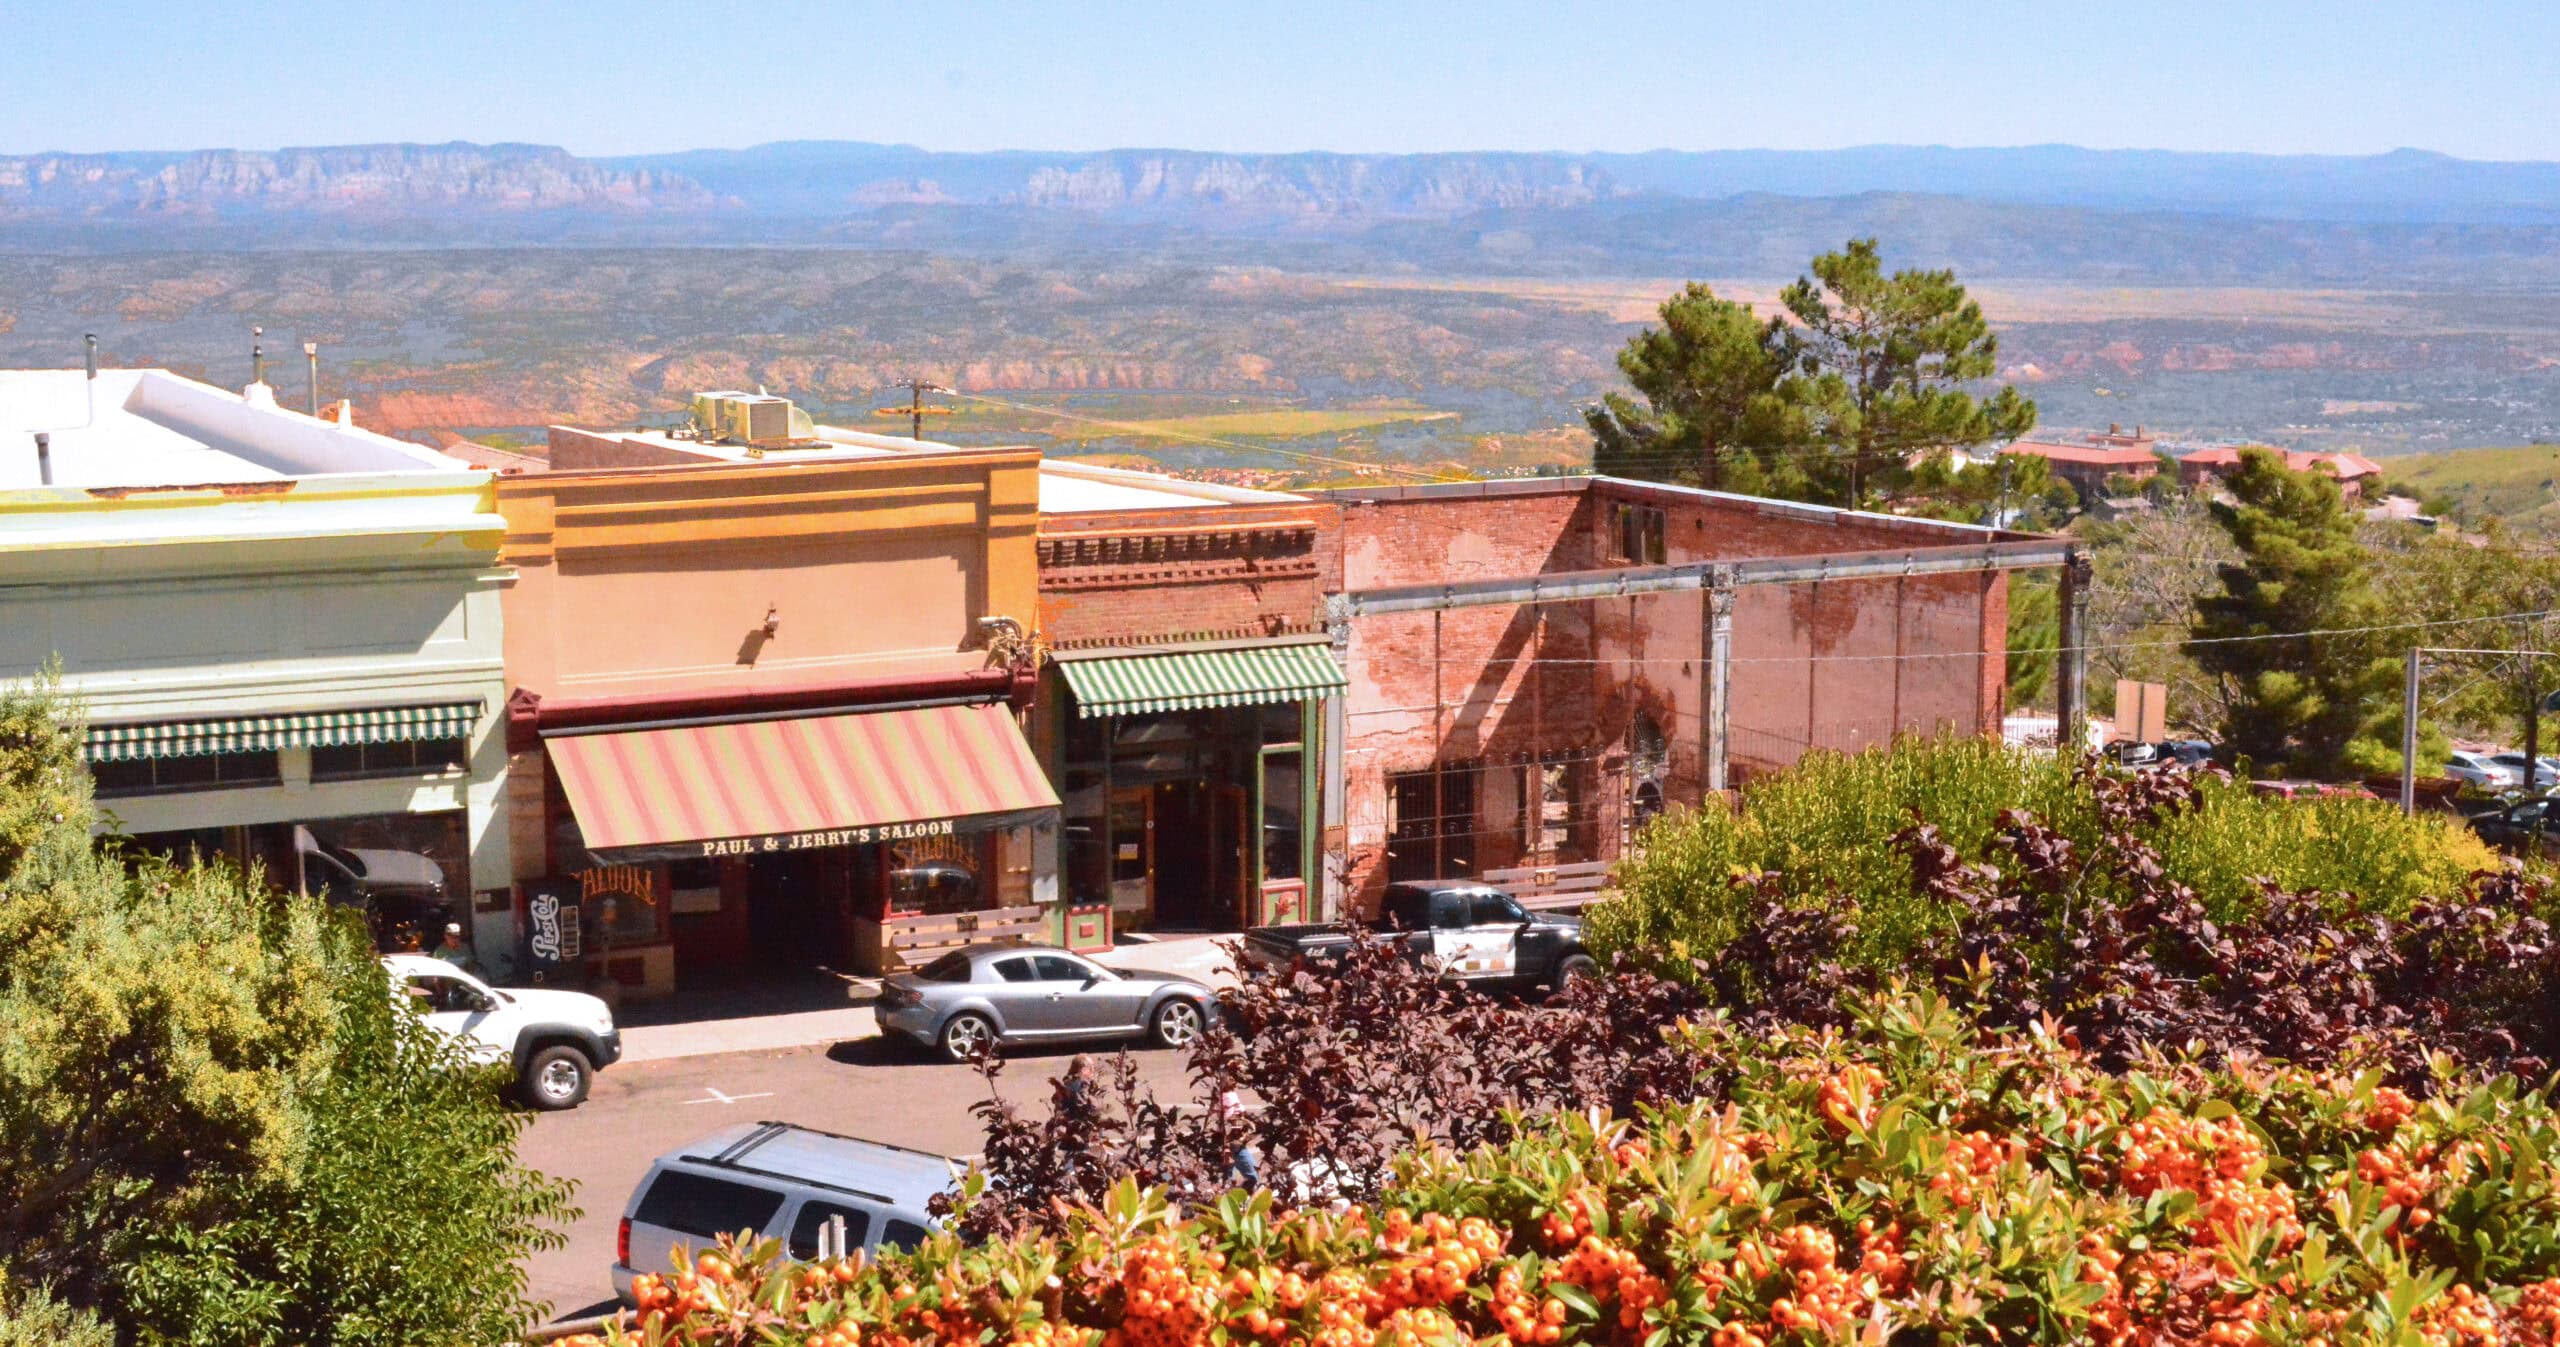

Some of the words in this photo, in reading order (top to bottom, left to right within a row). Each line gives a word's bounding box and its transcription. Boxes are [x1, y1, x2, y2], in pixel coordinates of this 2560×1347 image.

[702, 838, 755, 857] PAUL
[763, 837, 779, 851] &
[788, 828, 871, 849] JERRY'S
[879, 820, 953, 840] SALOON
[570, 864, 657, 905] ALOON
